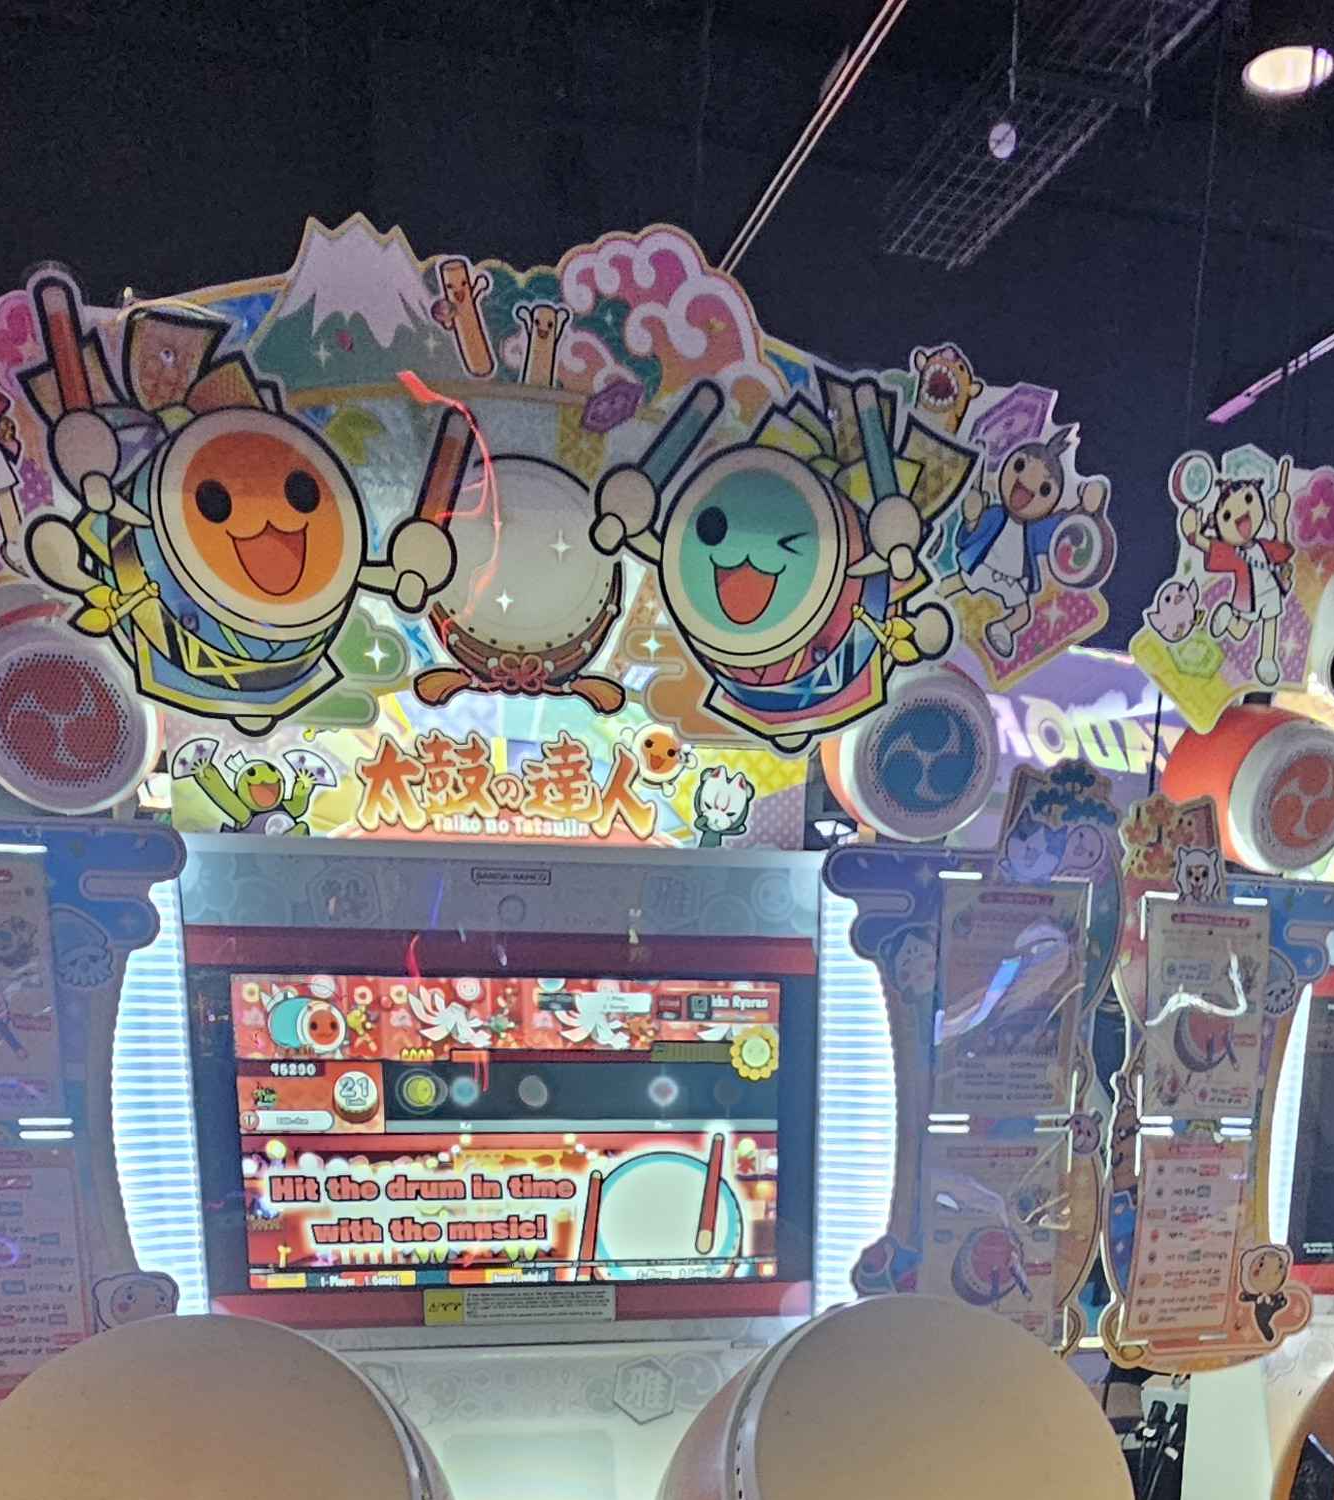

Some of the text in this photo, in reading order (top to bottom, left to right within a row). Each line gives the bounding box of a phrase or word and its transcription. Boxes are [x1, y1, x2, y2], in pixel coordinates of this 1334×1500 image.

[355, 728, 658, 840] 太鼓の達人
[433, 814, 591, 837] Taiko no Tatsujin
[338, 1075, 370, 1098] 21
[269, 1174, 577, 1202] Hit the drum in time
[311, 1215, 548, 1243] with the music!
